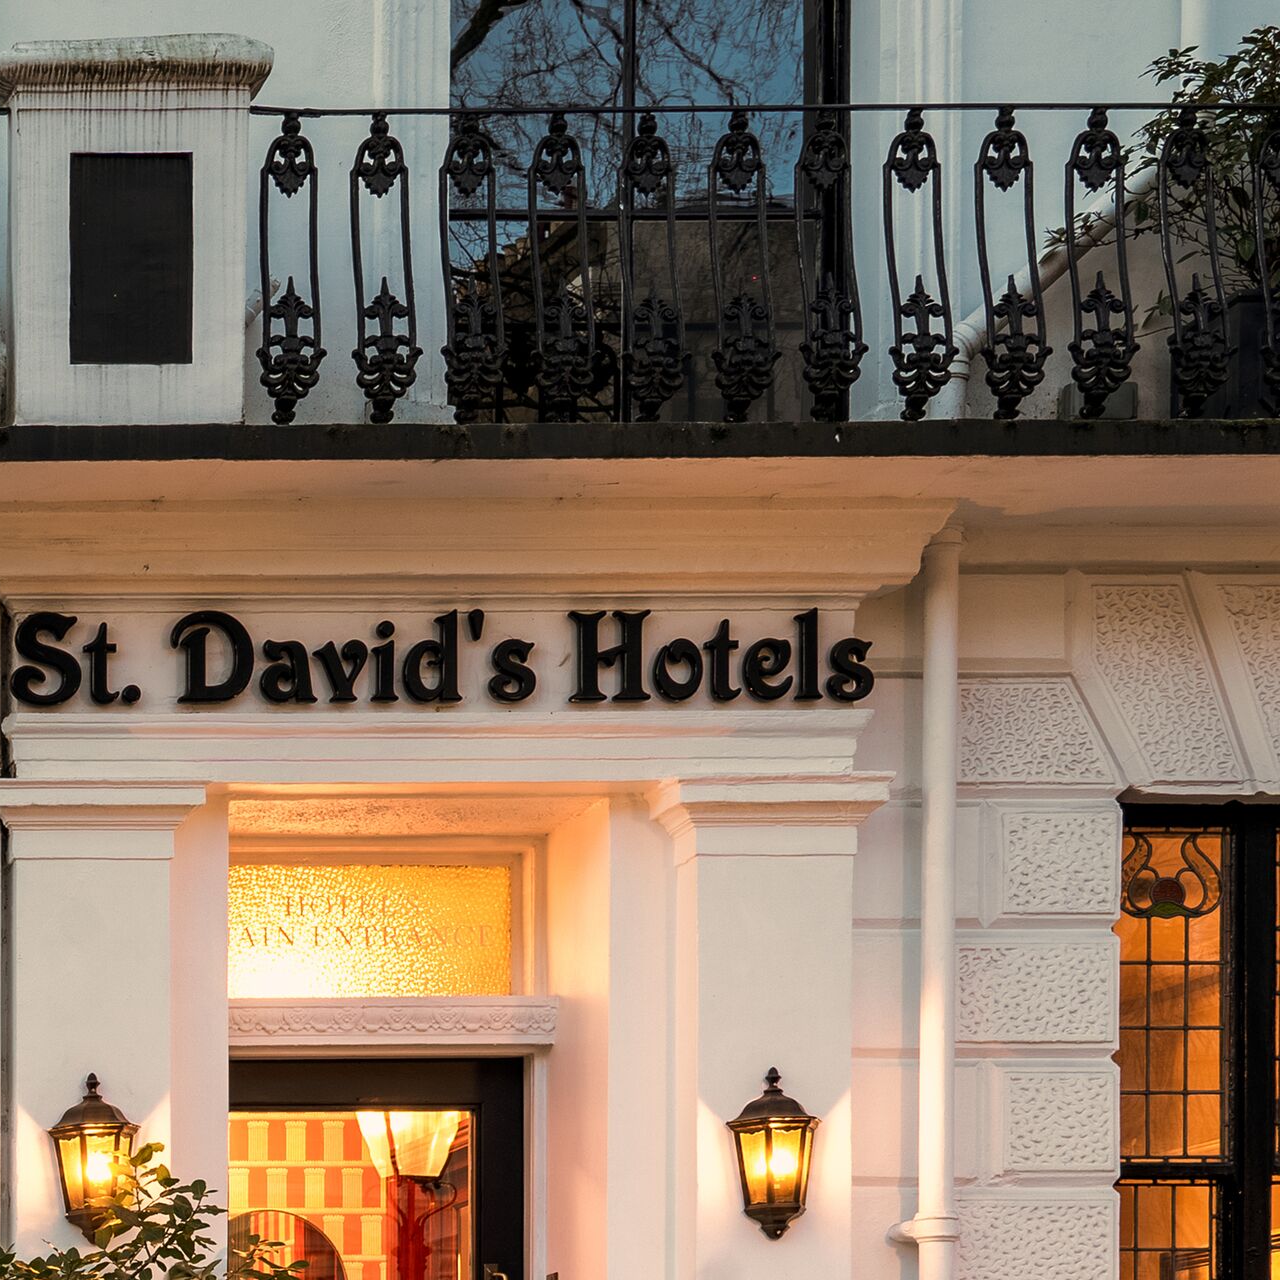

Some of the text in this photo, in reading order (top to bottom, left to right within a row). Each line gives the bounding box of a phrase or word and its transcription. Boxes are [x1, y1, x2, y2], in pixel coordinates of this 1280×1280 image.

[9, 607, 875, 705] St. David's Hotels
[230, 925, 494, 947] AIN ENTRANCE
